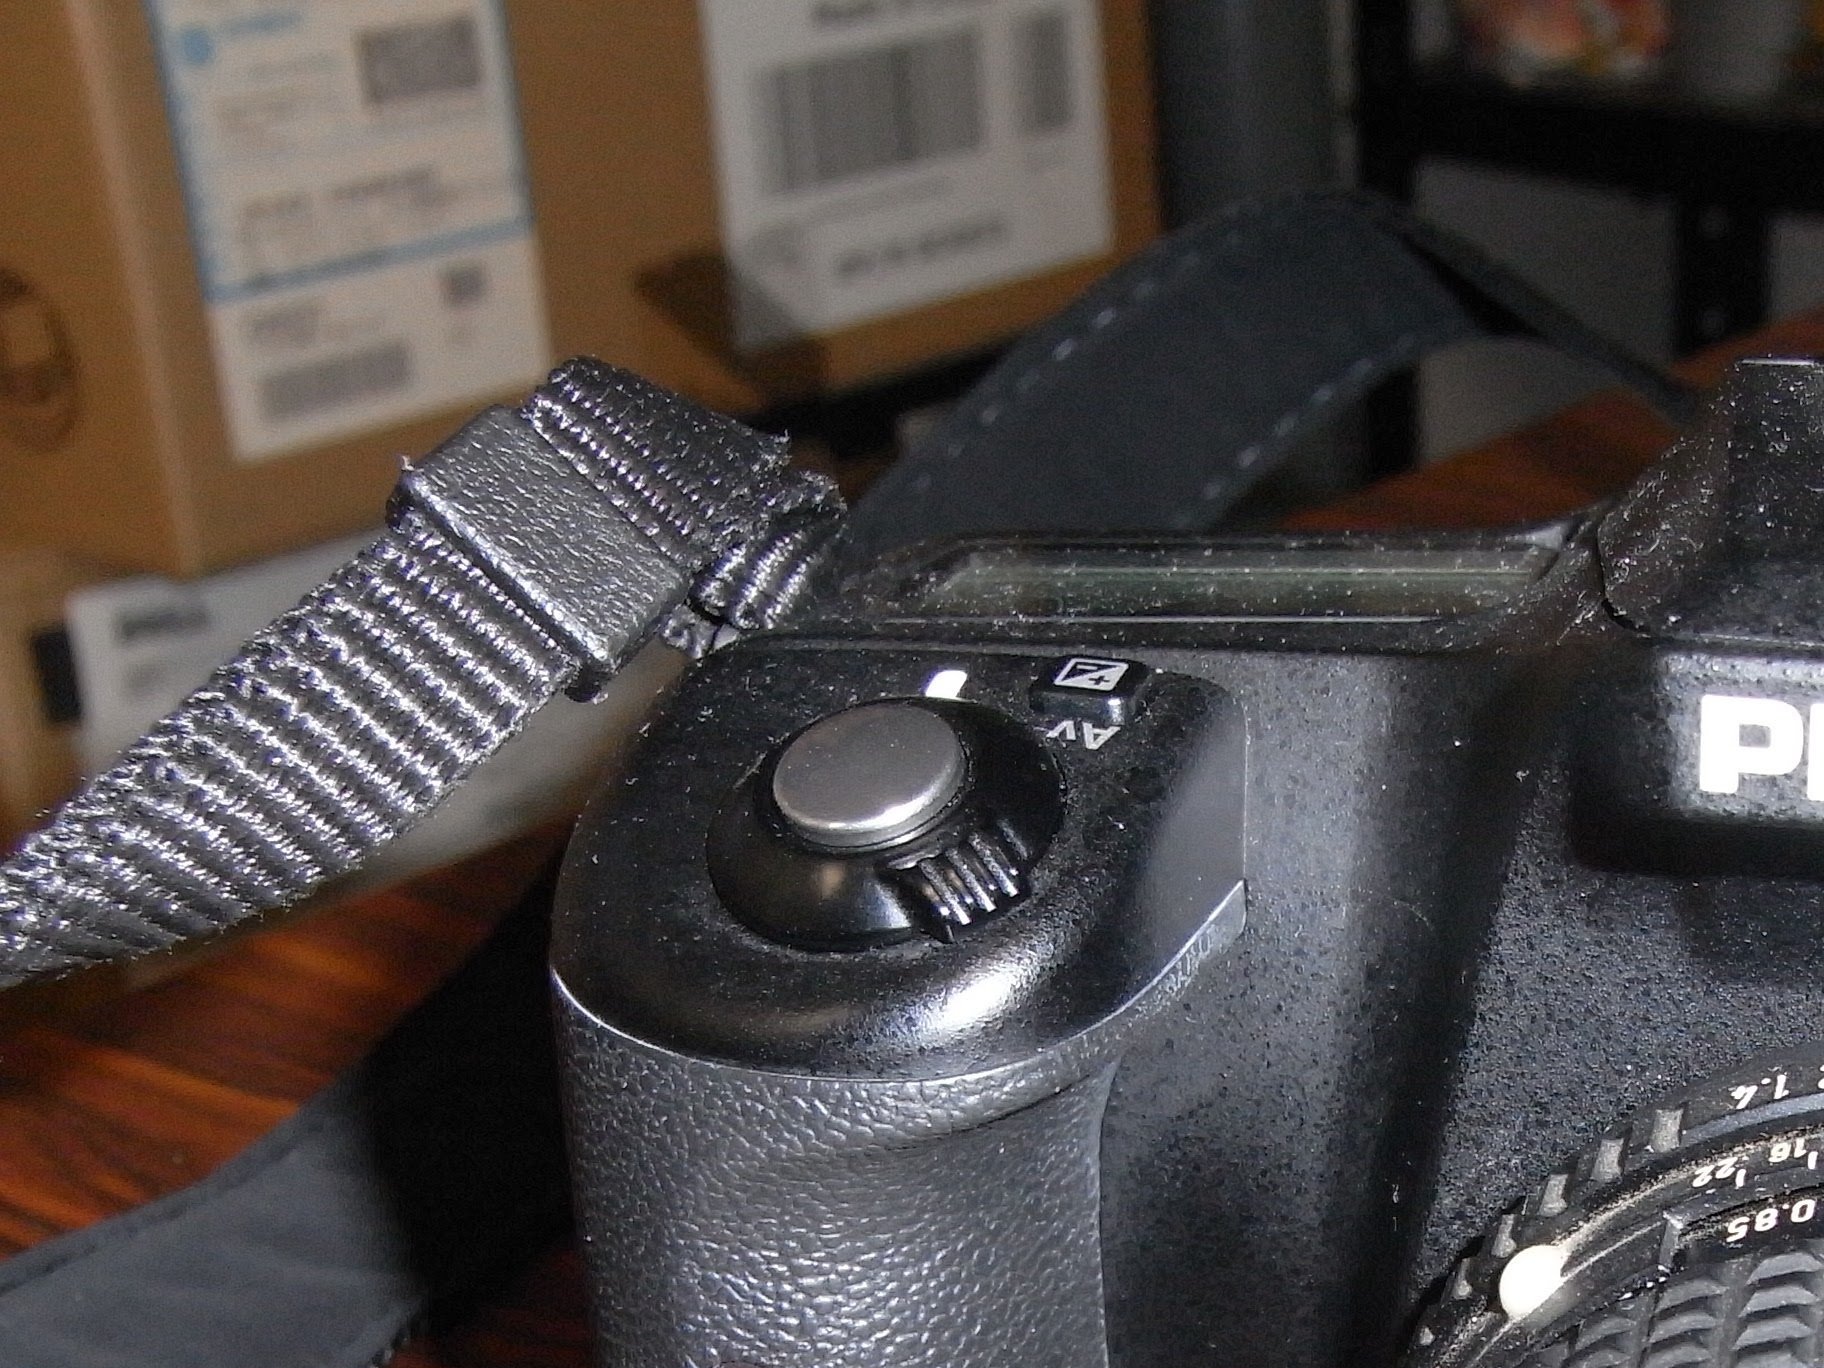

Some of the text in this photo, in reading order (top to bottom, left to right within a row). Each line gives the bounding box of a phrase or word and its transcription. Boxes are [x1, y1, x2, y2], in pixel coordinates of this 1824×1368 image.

[1046, 720, 1120, 750] Av
[1730, 1074, 1791, 1110] 1.4
[1768, 1138, 1808, 1163] 16
[1692, 1156, 1738, 1188] 22
[1725, 1199, 1816, 1243] 0.85
